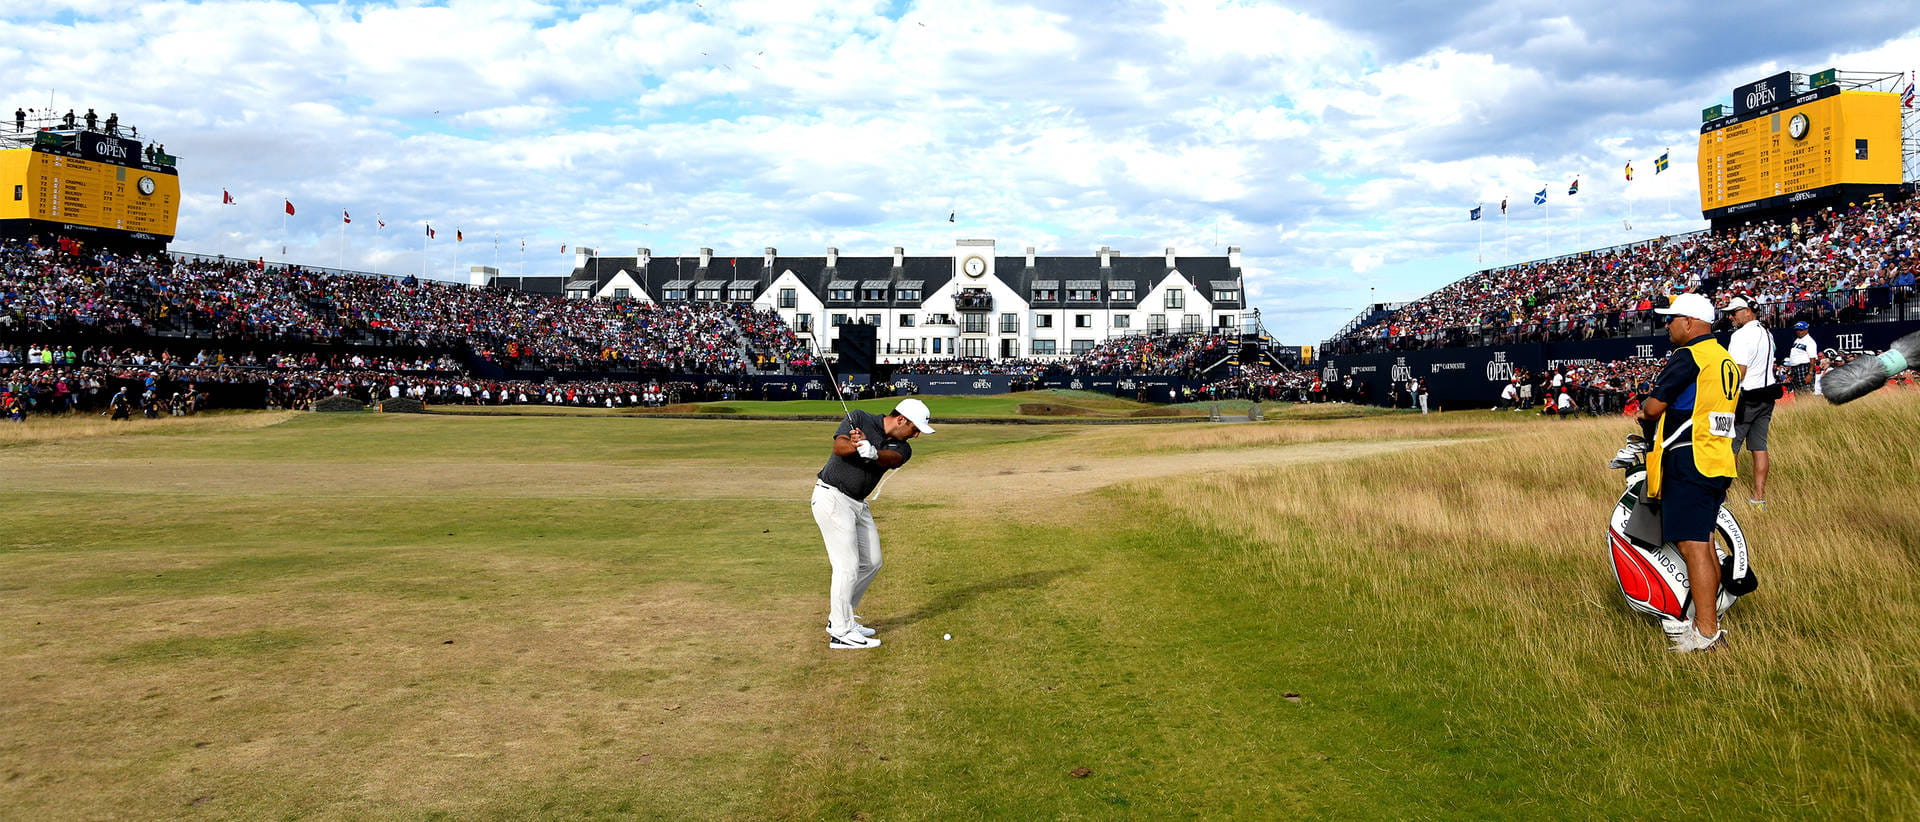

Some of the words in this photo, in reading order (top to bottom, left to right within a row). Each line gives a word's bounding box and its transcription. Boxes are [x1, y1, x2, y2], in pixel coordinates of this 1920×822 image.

[1755, 82, 1768, 92] THE
[1746, 87, 1776, 109] OPEN
[96, 142, 127, 158] OPEN
[1836, 334, 1863, 350] THE
[1494, 352, 1506, 362] THE
[1636, 345, 1653, 358] THE
[1397, 357, 1406, 366] THE
[1564, 358, 1596, 367] CARNOUSTIE
[1323, 367, 1338, 382] OPEN
[1391, 364, 1412, 382] OPEN
[1487, 360, 1514, 382] OPEN
